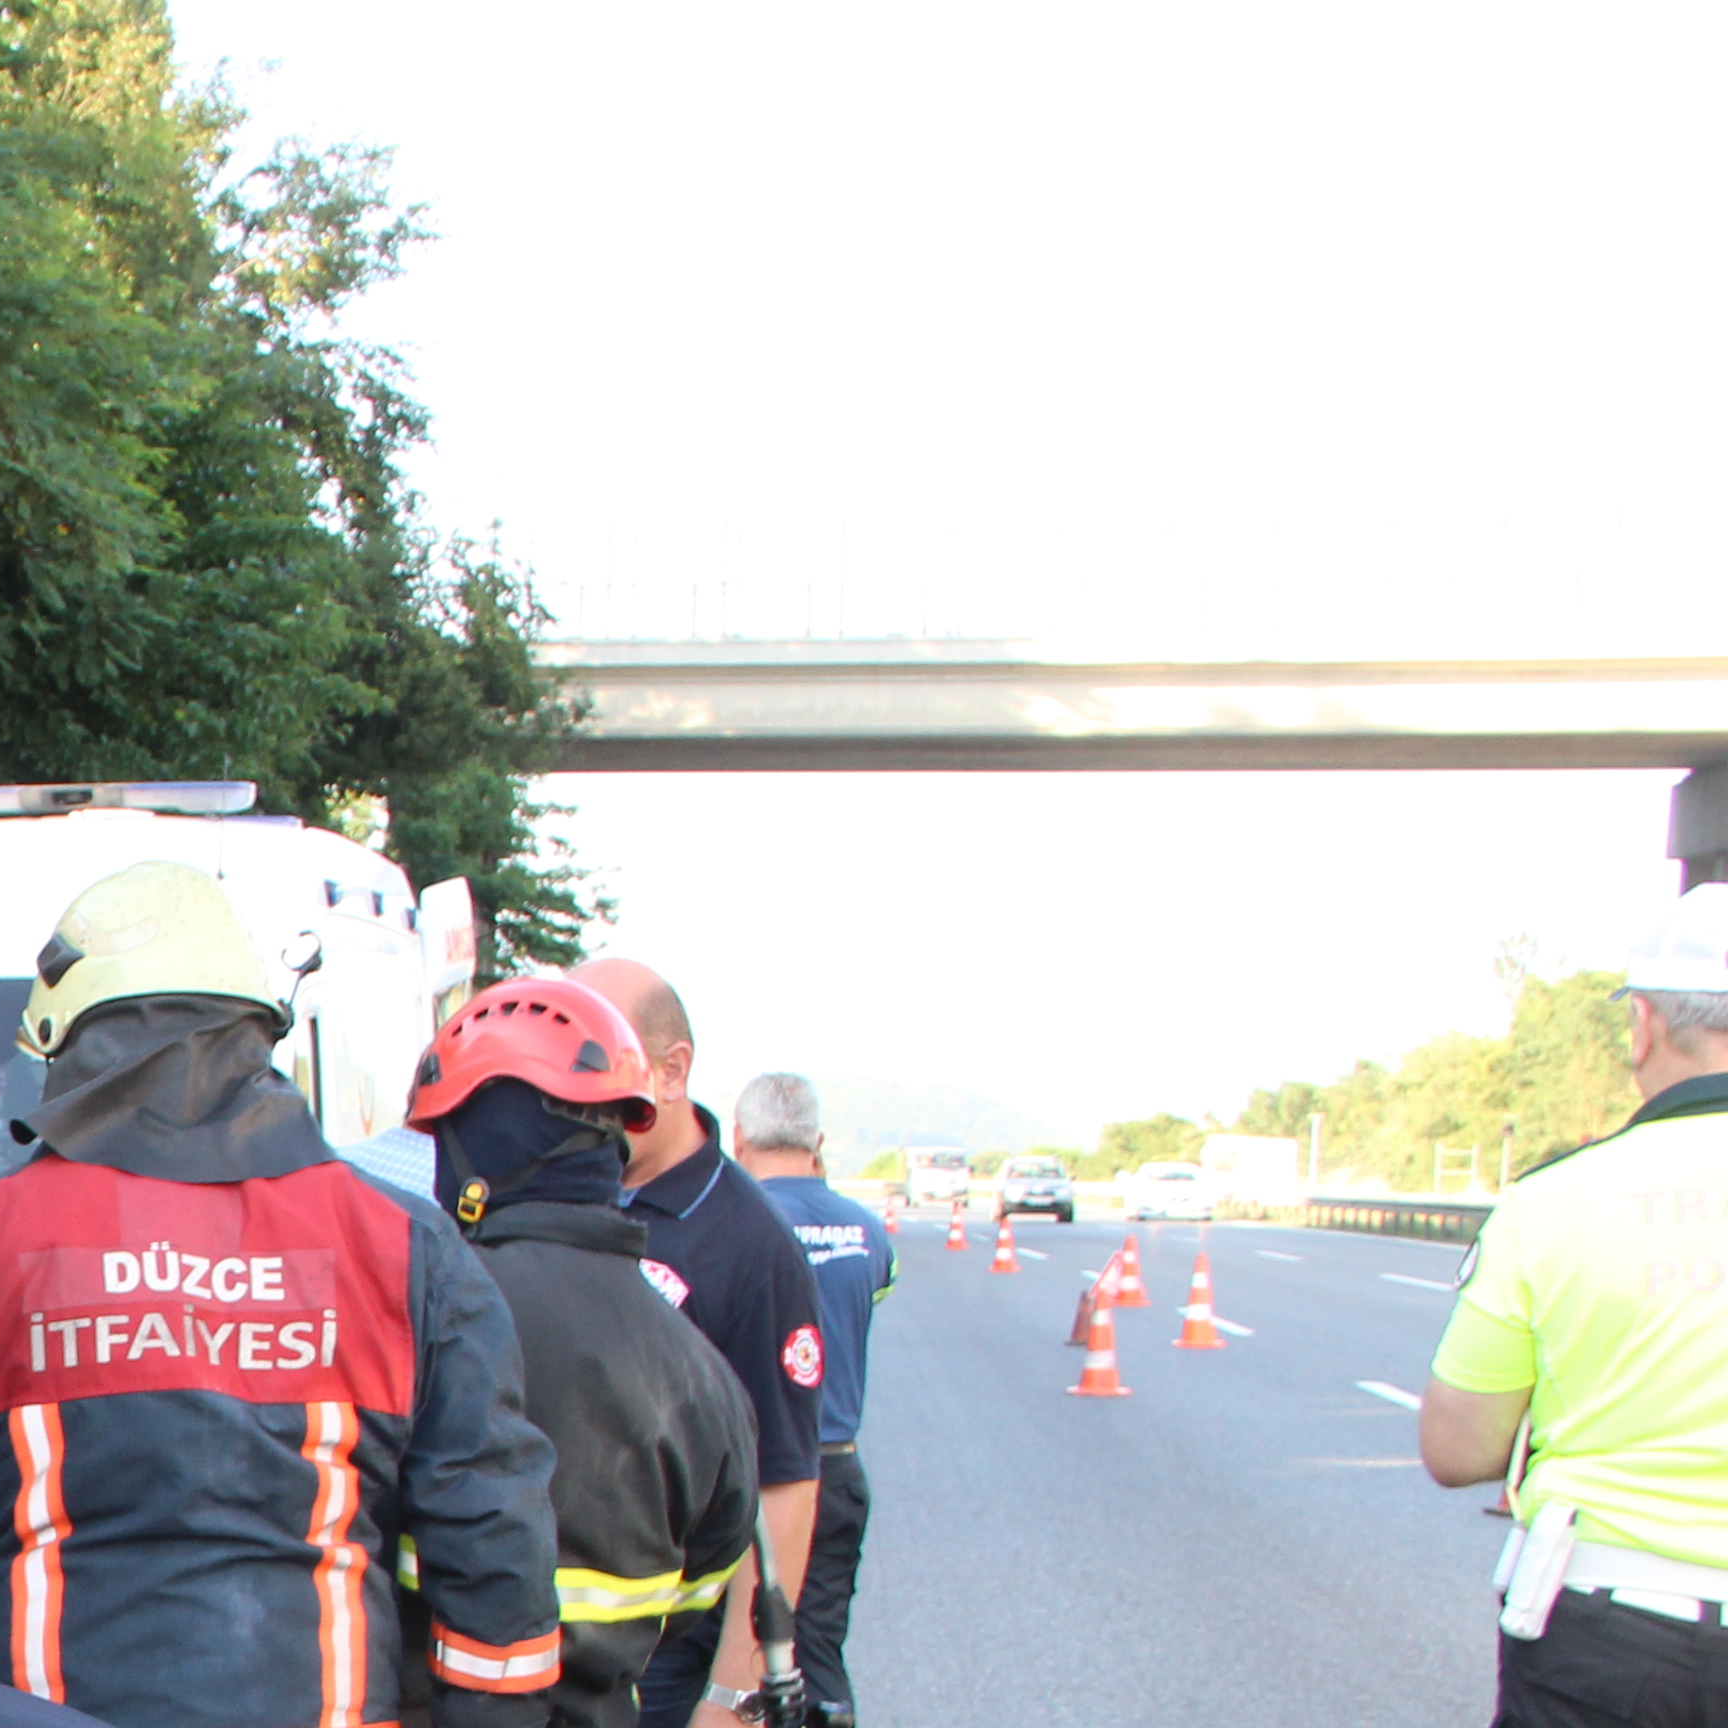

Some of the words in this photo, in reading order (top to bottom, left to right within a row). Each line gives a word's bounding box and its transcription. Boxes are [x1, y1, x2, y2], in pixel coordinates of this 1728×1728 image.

[1632, 1188, 1728, 1225] TR
[102, 1240, 285, 1301] DÜZCE
[28, 1303, 338, 1372] İTFAİYESİ
